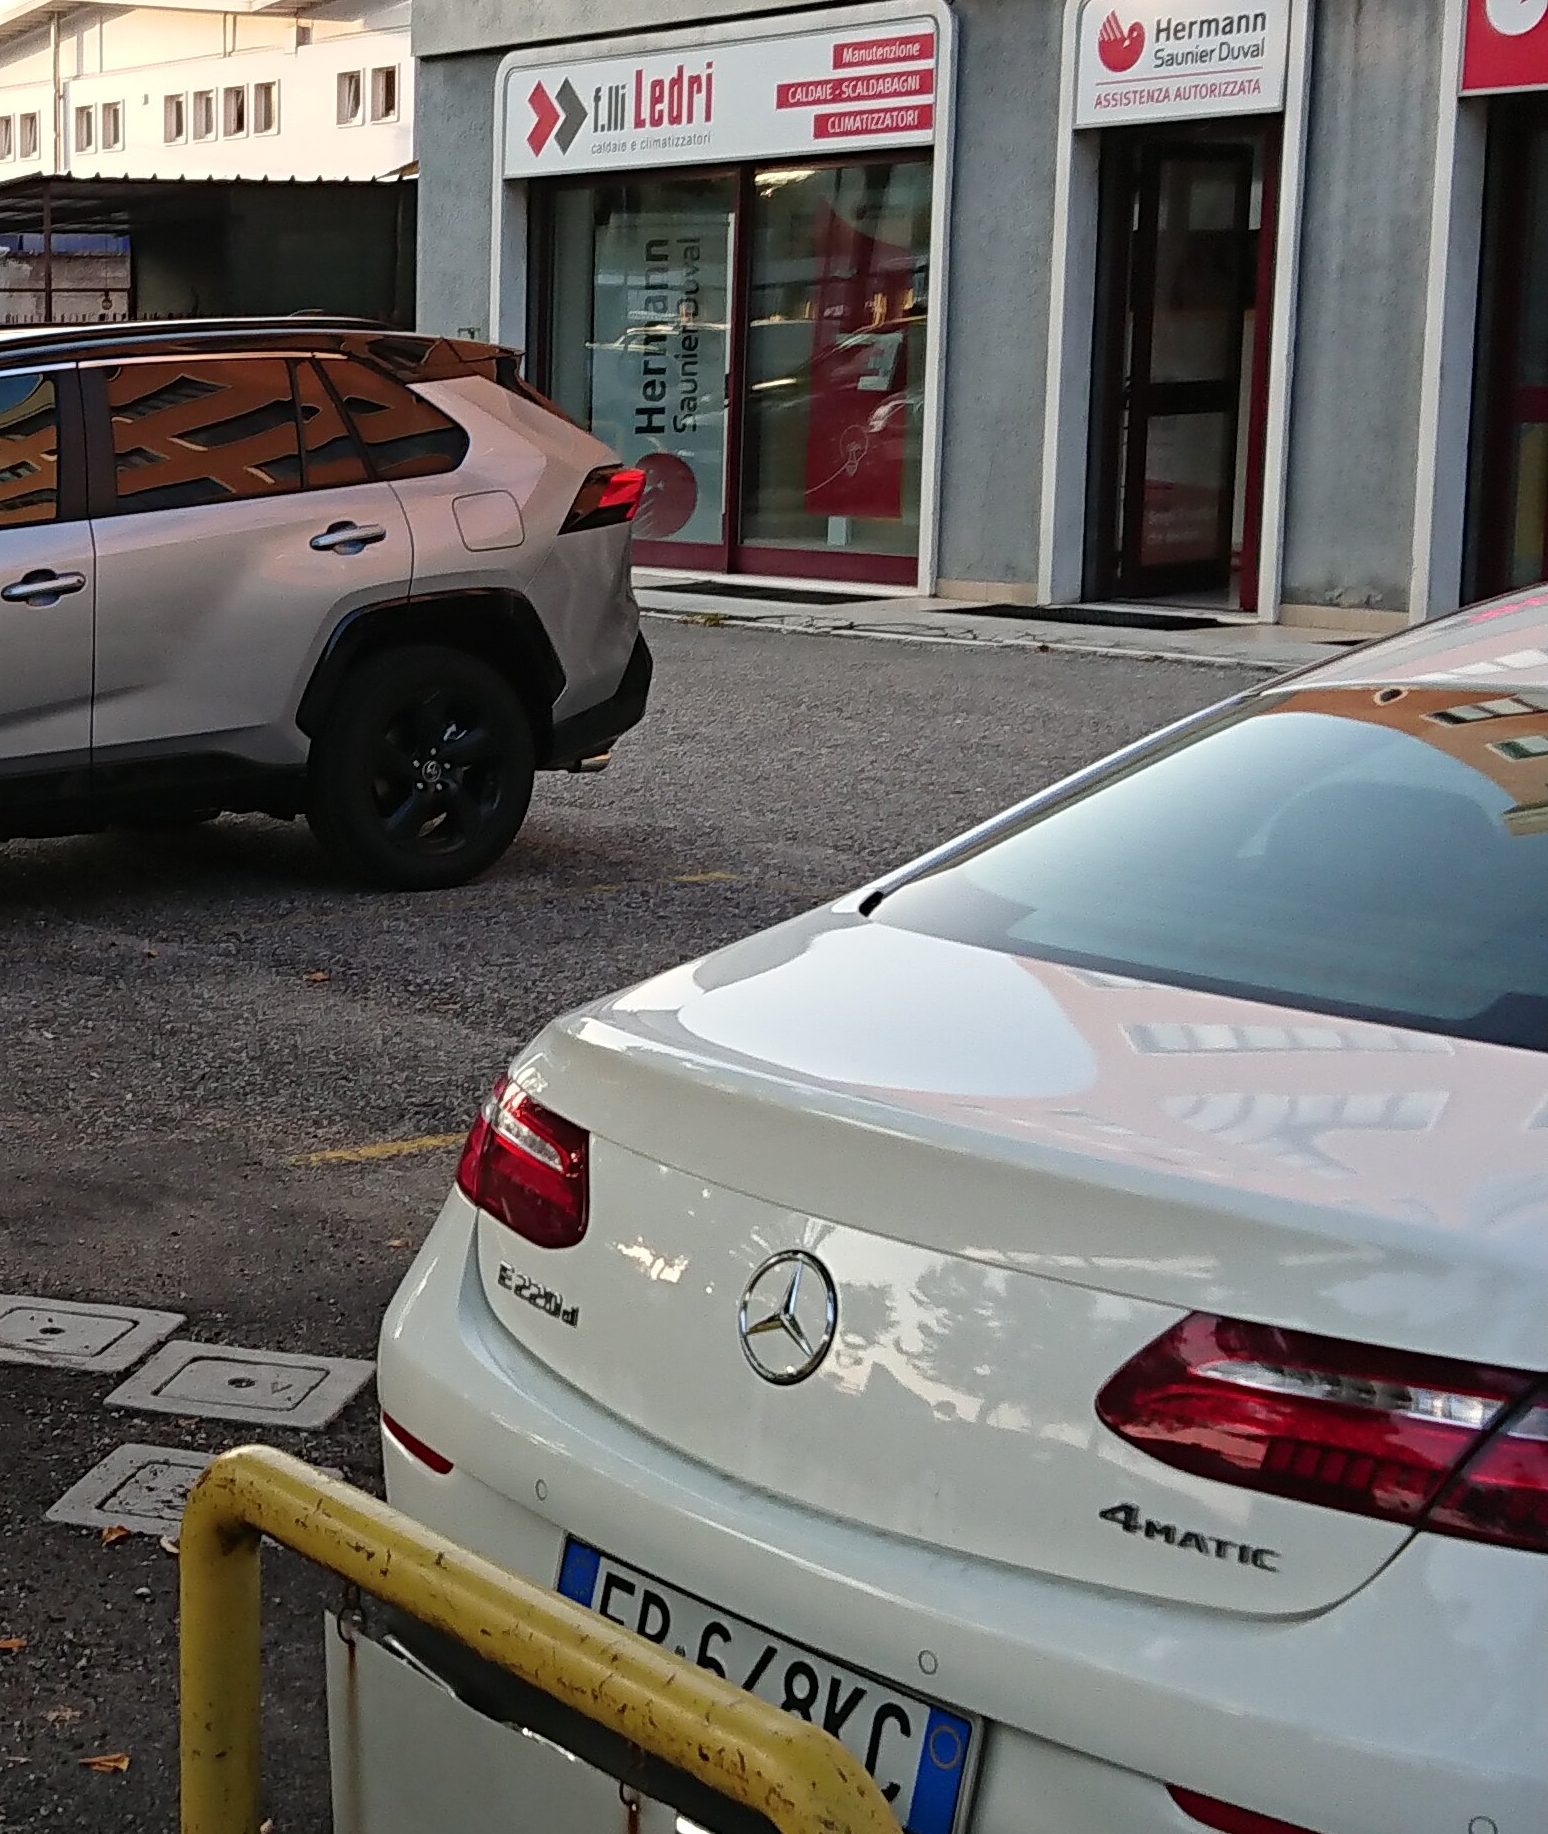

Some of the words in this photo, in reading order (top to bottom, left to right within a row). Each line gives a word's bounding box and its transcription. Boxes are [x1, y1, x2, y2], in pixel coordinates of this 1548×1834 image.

[1154, 12, 1267, 44] Hermann
[842, 41, 920, 64] Manutenzione
[1153, 45, 1215, 69] Saunier
[1218, 37, 1265, 62] Duval
[633, 60, 714, 129] Ledri
[788, 83, 833, 103] CALDAIE
[841, 74, 920, 99] SCALDABAGNI
[1094, 87, 1171, 110] ASSISTENZA
[1174, 78, 1262, 103] AUTORIZZATA
[827, 109, 919, 133] CLIMATIZZATORI
[640, 131, 711, 150] climatizzatori
[634, 238, 669, 435] Hermann
[1099, 1503, 1282, 1573] 4MATIC
